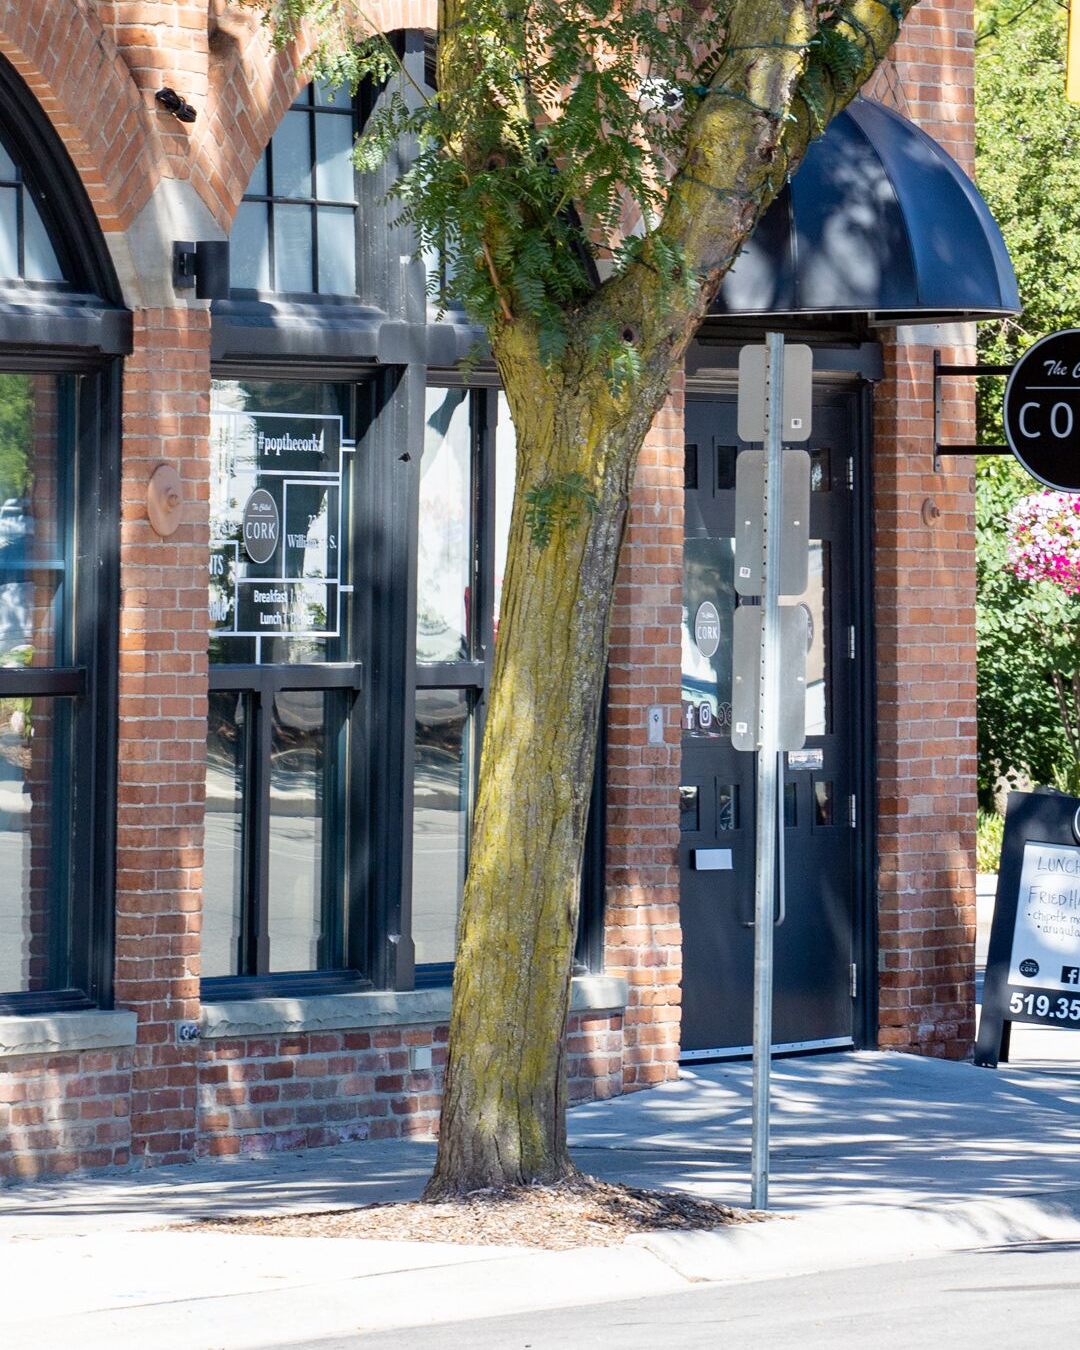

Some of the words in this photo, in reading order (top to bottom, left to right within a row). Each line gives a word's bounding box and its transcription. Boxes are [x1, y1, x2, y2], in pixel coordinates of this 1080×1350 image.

[1043, 359, 1068, 376] The
[246, 522, 275, 539] CORK
[254, 589, 288, 603] Breakfast
[260, 611, 281, 625] Lunch
[697, 626, 718, 640] CORK
[1028, 885, 1067, 906] FRIED
